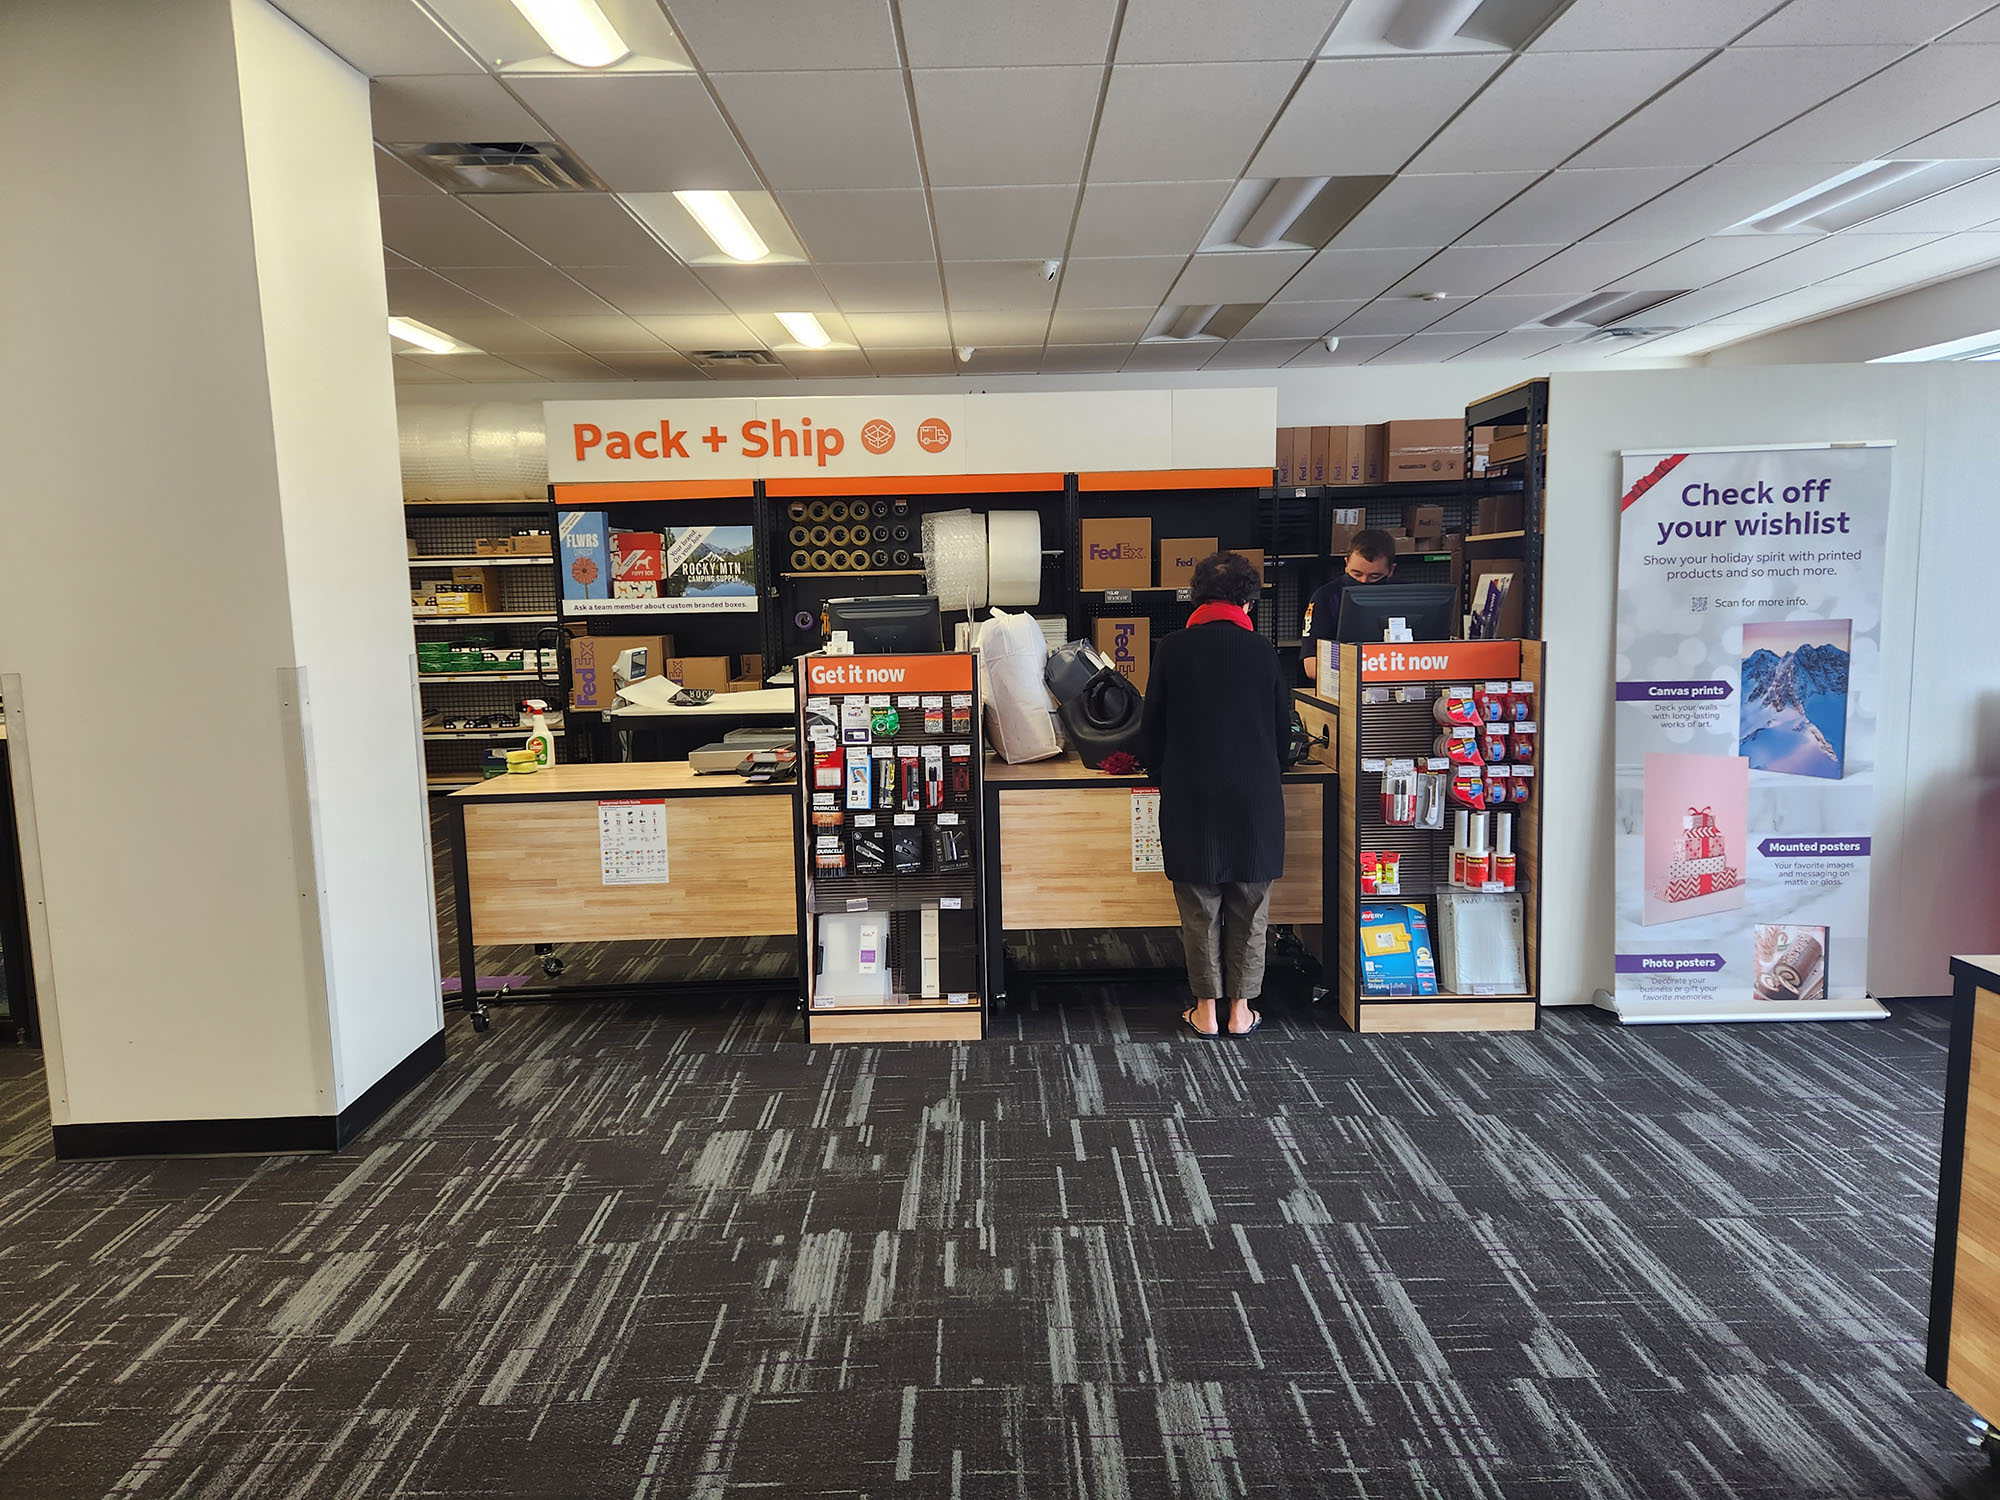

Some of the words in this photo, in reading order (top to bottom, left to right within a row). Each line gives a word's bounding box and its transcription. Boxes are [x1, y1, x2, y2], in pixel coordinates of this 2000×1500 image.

[574, 420, 690, 462] Pack
[702, 427, 727, 452] +
[742, 416, 844, 467] Ship
[1682, 481, 1773, 507] Check
[1783, 479, 1831, 503] off
[1657, 519, 1727, 545] your
[1735, 511, 1850, 536] wishlist
[566, 533, 599, 548] FLWRS
[680, 529, 697, 546] brand
[1090, 542, 1146, 560] FedEx
[1176, 557, 1197, 567] Fed
[1644, 555, 1676, 565] Show
[1680, 556, 1707, 567] your
[1711, 552, 1754, 565] holiday
[1757, 552, 1785, 564] spirit
[1789, 551, 1814, 561] with
[1818, 550, 1861, 563] printed
[682, 562, 716, 576] ROCKY
[720, 562, 745, 574] MTN.
[1667, 568, 1722, 581] products
[1727, 567, 1748, 577] and
[1768, 567, 1799, 577] much
[1803, 567, 1837, 576] more.
[1715, 599, 1739, 608] Scan
[1742, 597, 1755, 607] for
[1787, 597, 1808, 606] info.
[1391, 652, 1405, 671] it
[1409, 656, 1448, 670] now
[576, 640, 597, 706] FedEx
[811, 665, 846, 685] Get
[849, 664, 863, 683] it
[867, 668, 904, 683] now
[1649, 686, 1690, 697] Canvas
[1691, 685, 1724, 697] prints
[1677, 705, 1695, 713] your
[1652, 712, 1669, 720] with
[1672, 712, 1720, 721] long-lasting
[1769, 842, 1817, 853] Mounted
[1820, 843, 1860, 855] posters
[1774, 861, 1791, 870] Your
[1794, 861, 1824, 869] favorite
[1826, 862, 1855, 870] images
[1778, 870, 1794, 878] and
[1795, 871, 1837, 880] messaging
[1821, 878, 1843, 887] gloss.
[1362, 913, 1384, 921] AVERY
[1642, 957, 1674, 968] Photo
[1675, 958, 1716, 970] posters
[1689, 978, 1705, 986] your
[1639, 985, 1672, 993] business
[1684, 985, 1701, 994] gift
